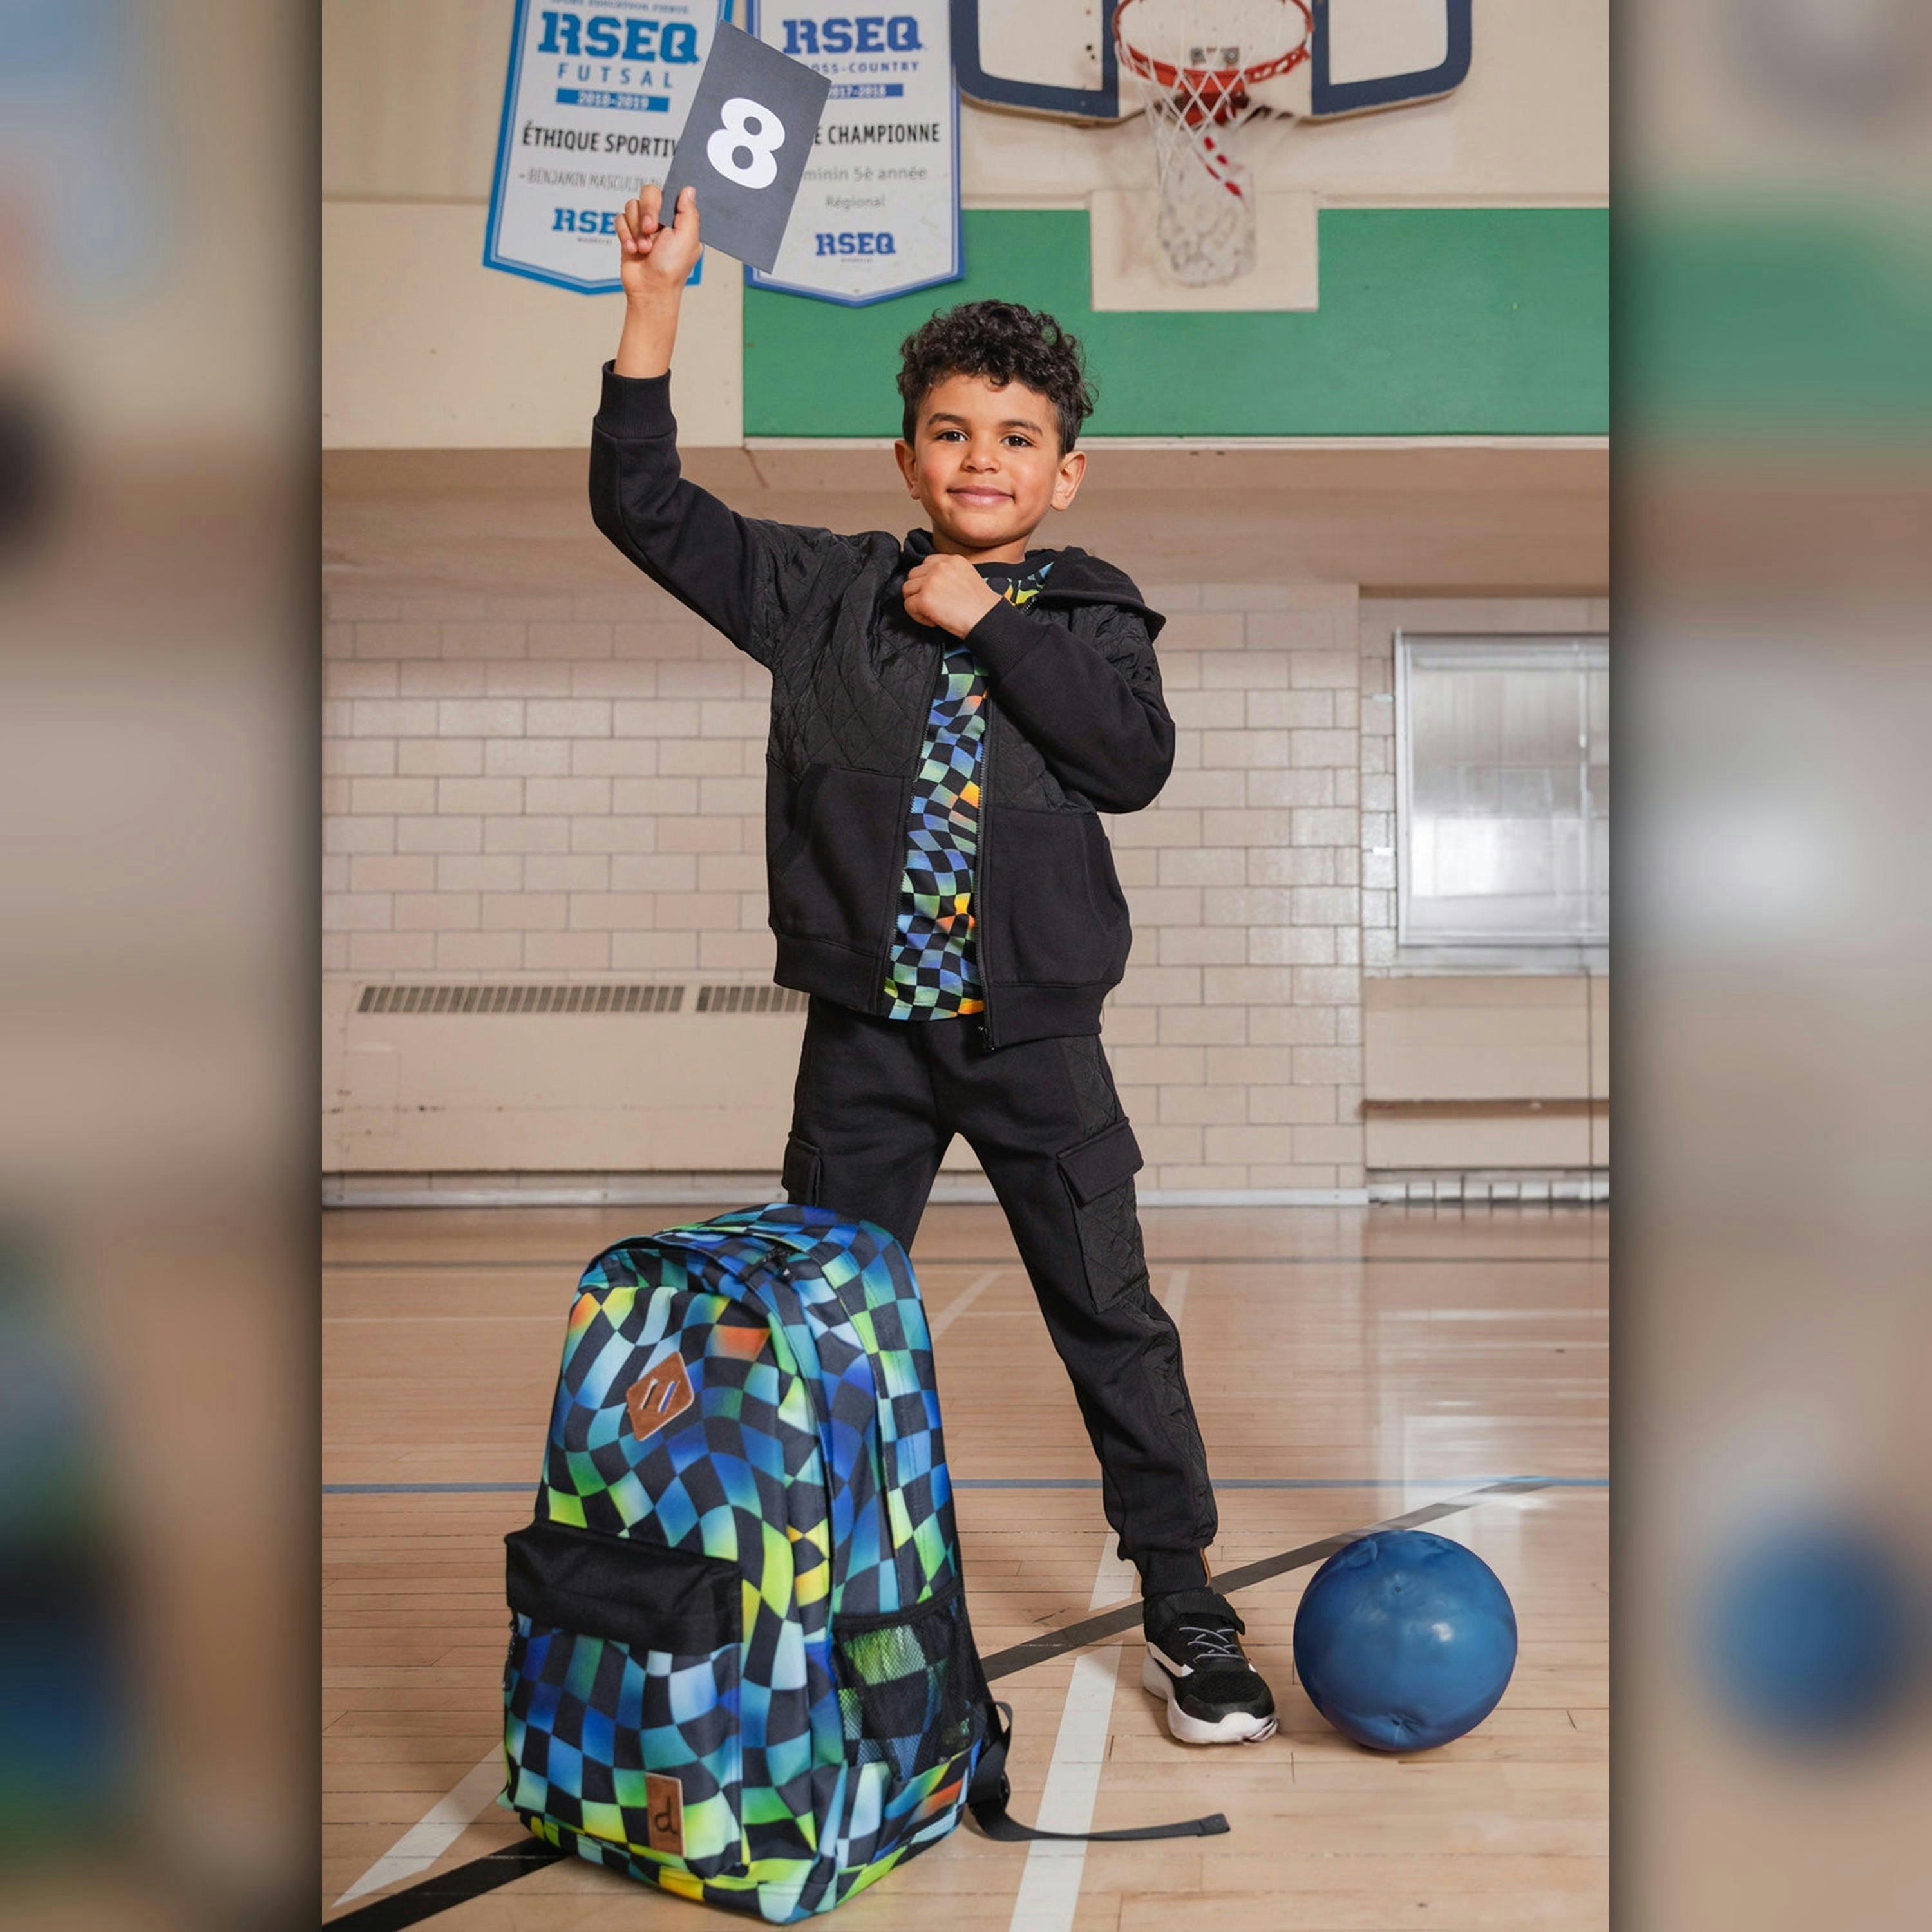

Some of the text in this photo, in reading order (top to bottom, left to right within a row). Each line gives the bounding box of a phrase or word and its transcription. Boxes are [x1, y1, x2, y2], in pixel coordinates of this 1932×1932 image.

[538, 11, 700, 64] RSEQ
[782, 15, 923, 54] RSEQ
[557, 62, 673, 89] FUTSAL
[810, 61, 919, 74] OSS-COUNTRY
[522, 118, 679, 158] ÉTHIQUE SPORTIV
[707, 97, 786, 189] 8
[828, 122, 940, 145] CHAMPIONNE
[528, 168, 587, 188] BENJAMIN
[804, 166, 849, 181] minin
[878, 166, 927, 181] année
[825, 195, 886, 210] Régional
[552, 207, 617, 236] RSE
[815, 232, 896, 256] RSEQ
